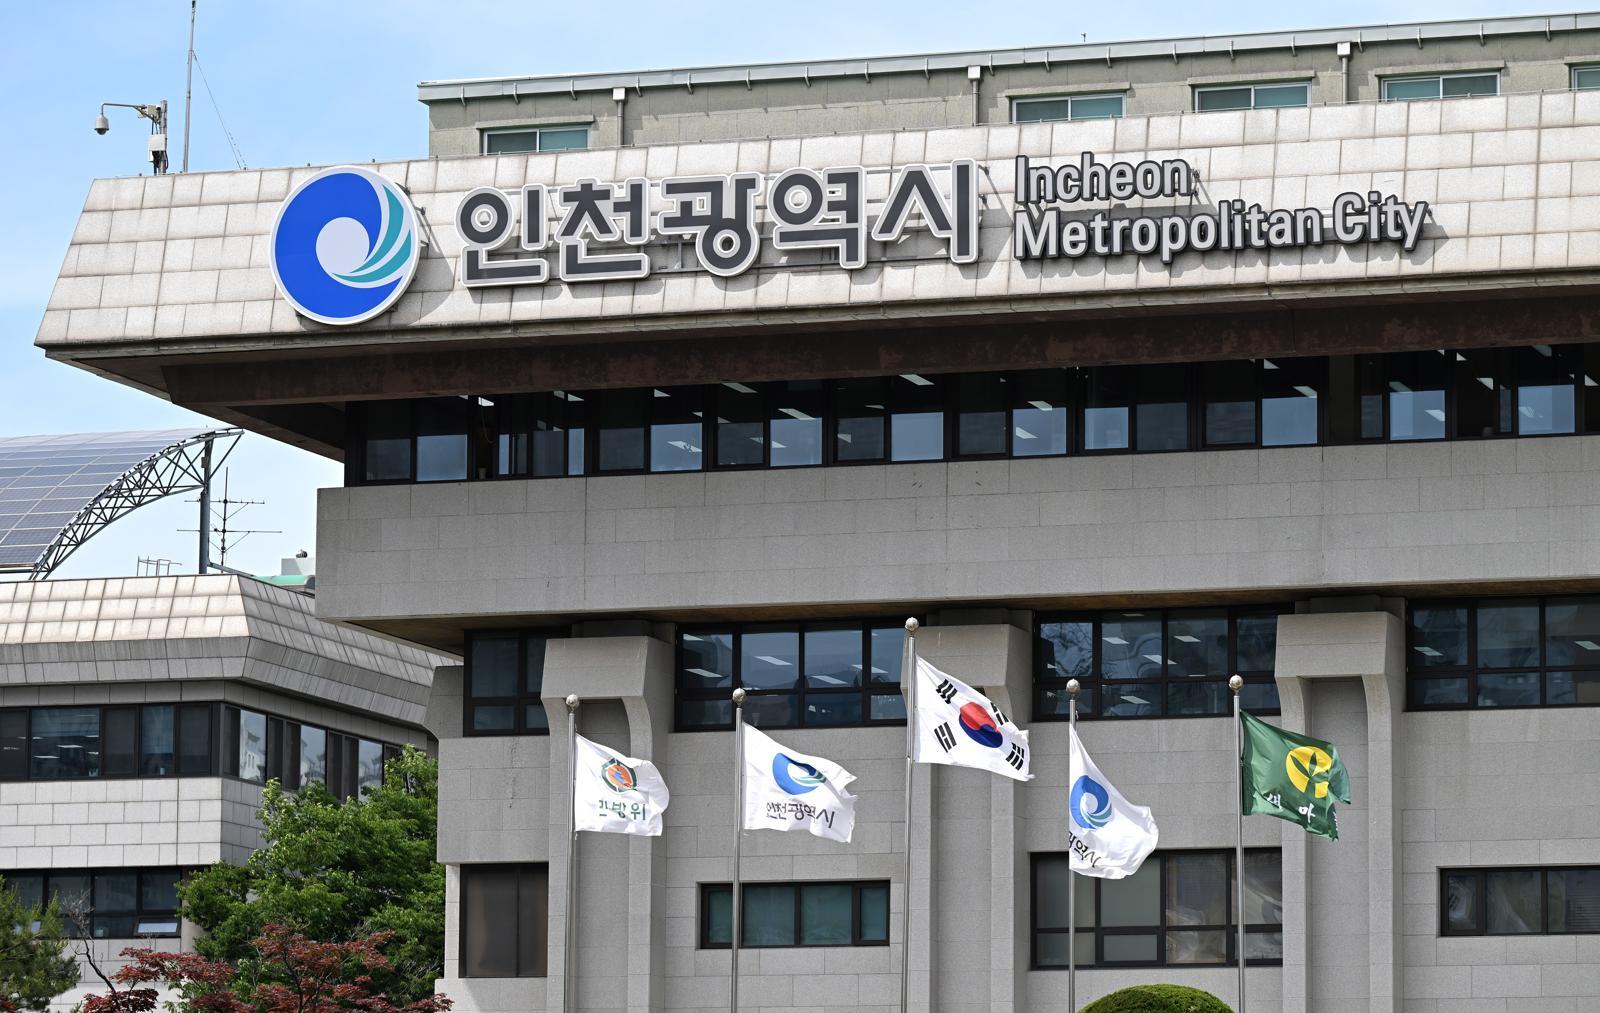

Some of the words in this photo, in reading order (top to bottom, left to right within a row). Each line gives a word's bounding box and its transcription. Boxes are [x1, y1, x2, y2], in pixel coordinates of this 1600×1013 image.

[1015, 152, 1190, 206] Incheon
[455, 158, 978, 288] 인천광역시
[1014, 200, 1323, 264] Metropolitan
[1332, 191, 1429, 252] City
[766, 802, 836, 829] 인천광역시
